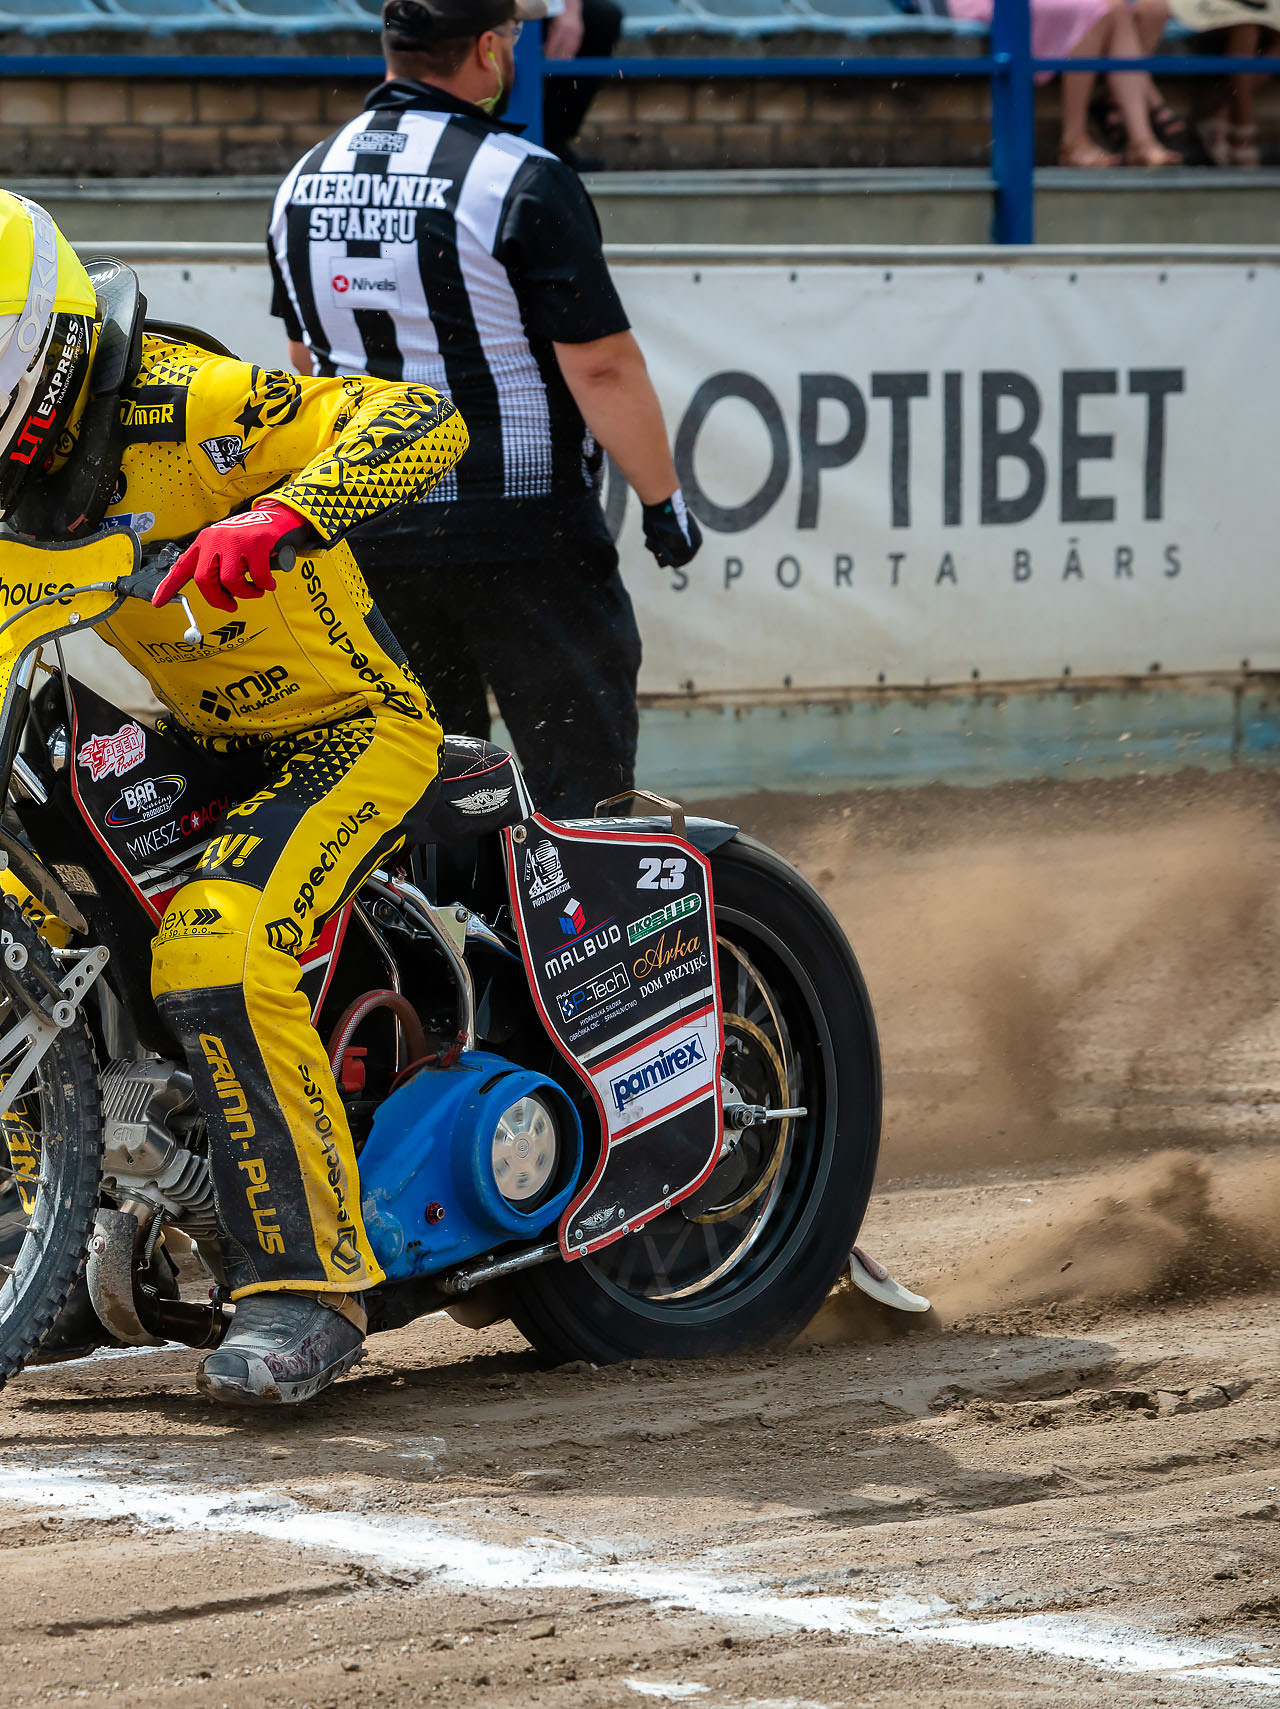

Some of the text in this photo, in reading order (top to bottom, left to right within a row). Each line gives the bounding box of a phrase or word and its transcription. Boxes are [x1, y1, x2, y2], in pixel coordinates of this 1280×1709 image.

[291, 173, 454, 209] KIEROWNIK
[309, 207, 418, 243] STARTU
[352, 278, 397, 291] Nivels
[674, 368, 1186, 534] OPTIBET
[671, 537, 1184, 592] SPORTA BĀRS
[154, 652, 195, 664] Logistics
[225, 665, 290, 702] mjp
[239, 682, 301, 714] drukarnia
[124, 781, 158, 810] BAR
[142, 803, 171, 819] PRODUCTS
[294, 801, 381, 920] spechouse
[636, 857, 687, 890] 23
[628, 894, 701, 940] EKOBUD
[545, 924, 621, 980] MALBUD
[633, 929, 700, 978] Arka
[639, 952, 708, 998] DOM PRZYJĘĆ
[569, 1027, 590, 1042] OBRÓBKA
[590, 1020, 600, 1032] CNC
[579, 1009, 605, 1026] HYDRAULIKA
[613, 1039, 703, 1112] pamirex
